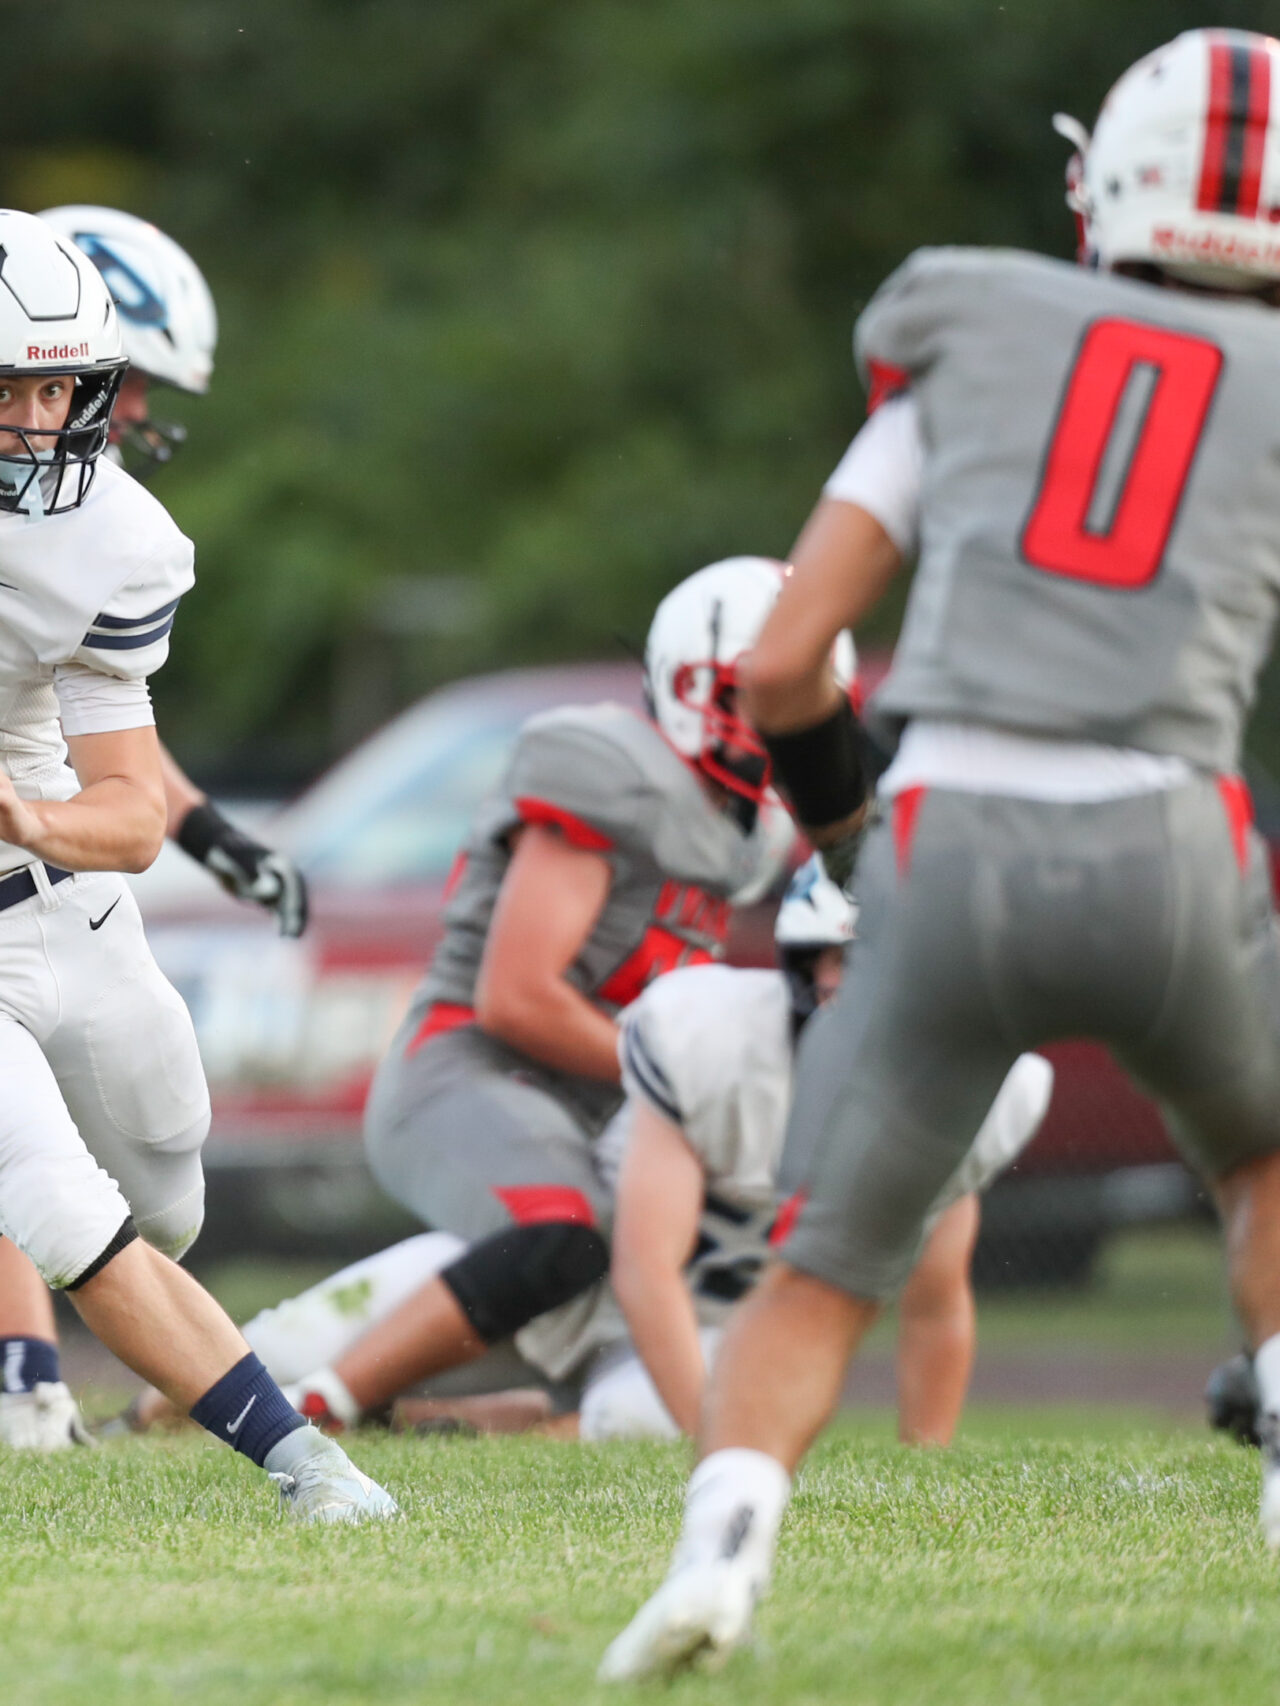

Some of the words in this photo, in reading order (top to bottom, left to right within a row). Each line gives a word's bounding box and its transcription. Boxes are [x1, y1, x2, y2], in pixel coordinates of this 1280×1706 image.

[26, 342, 89, 361] Riddell
[69, 389, 108, 430] Riddell
[1018, 314, 1227, 590] 0
